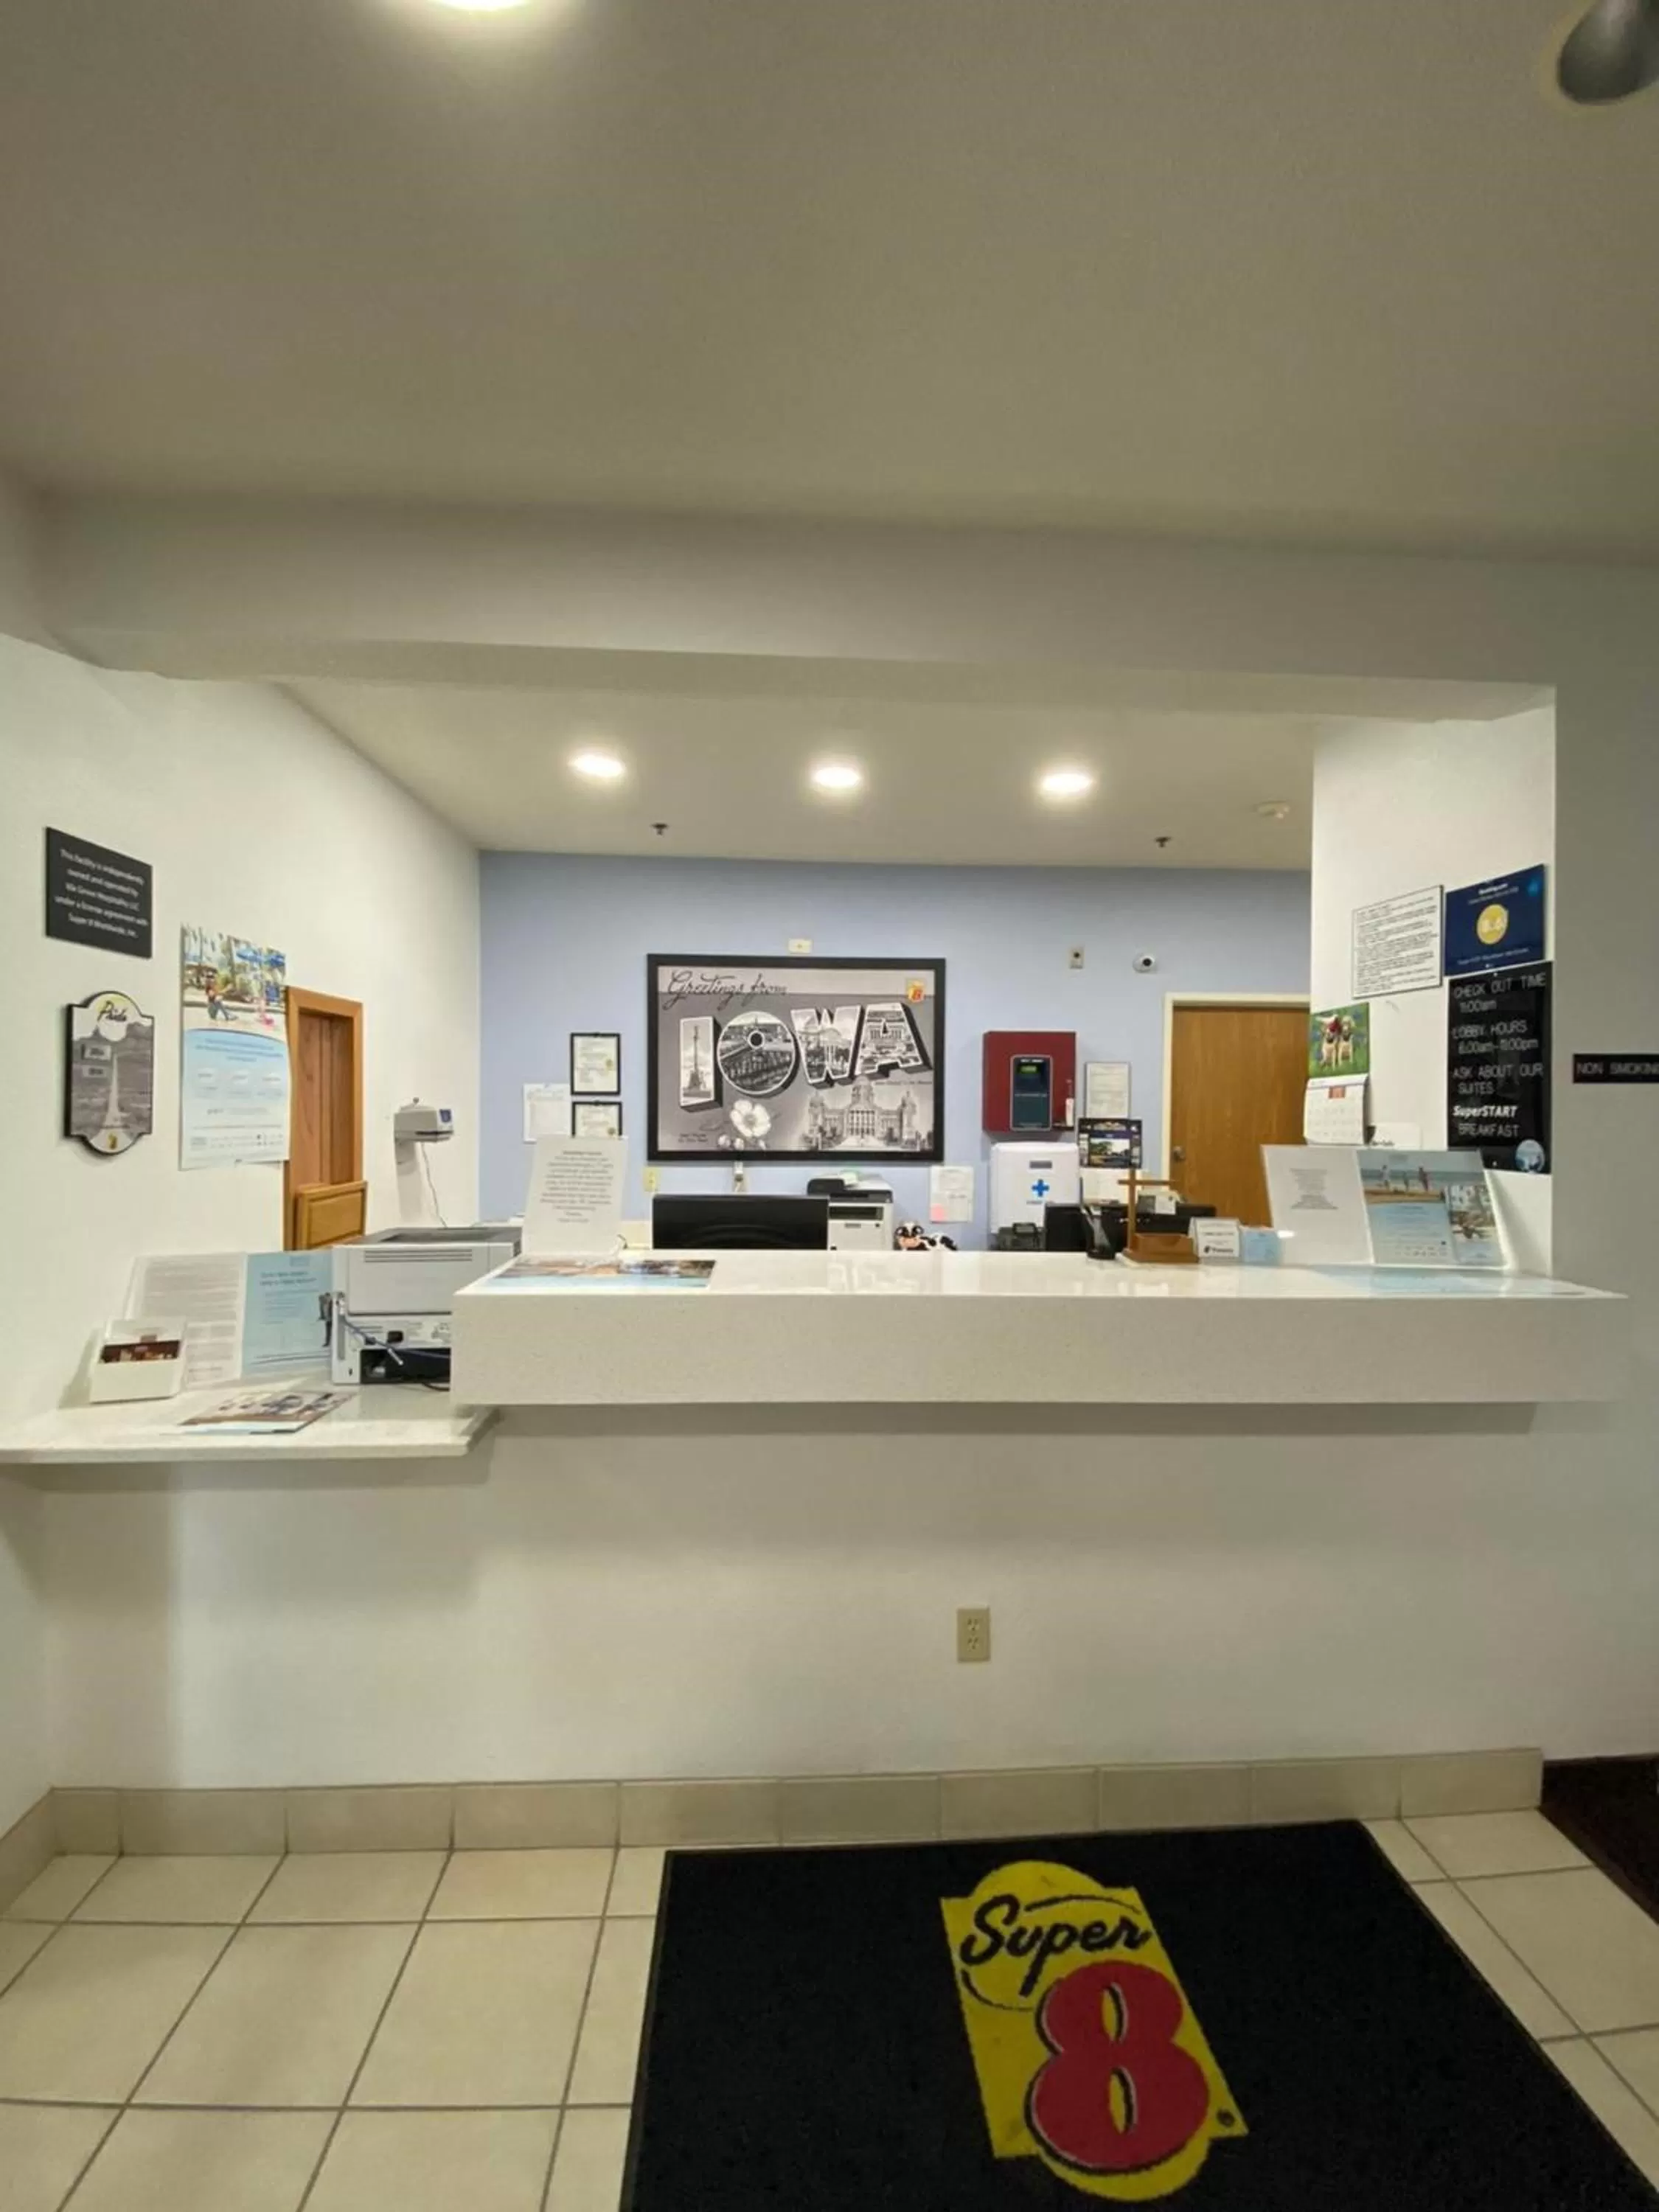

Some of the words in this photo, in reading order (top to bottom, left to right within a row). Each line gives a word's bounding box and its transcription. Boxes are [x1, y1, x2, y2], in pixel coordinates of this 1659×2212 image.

[662, 970, 744, 1012] Greetings
[741, 973, 788, 1007] from
[1453, 984, 1486, 999] CHECK
[1491, 977, 1512, 994] OUT
[1520, 971, 1546, 989] TIME
[1451, 1023, 1485, 1040] LOBBY
[1490, 1019, 1528, 1036] HOURS
[679, 1002, 933, 1113] IOWA
[1576, 1062, 1604, 1074] NON
[1453, 1066, 1473, 1079] ASK
[1478, 1064, 1514, 1079] ABOUT
[1520, 1062, 1544, 1077] OUR
[1458, 1081, 1495, 1095] SUITES
[1453, 1105, 1518, 1119] SuperSTART
[1458, 1123, 1520, 1137] BREAKFAST
[960, 1894, 1153, 1997] Super
[1025, 1959, 1210, 2176] 8
